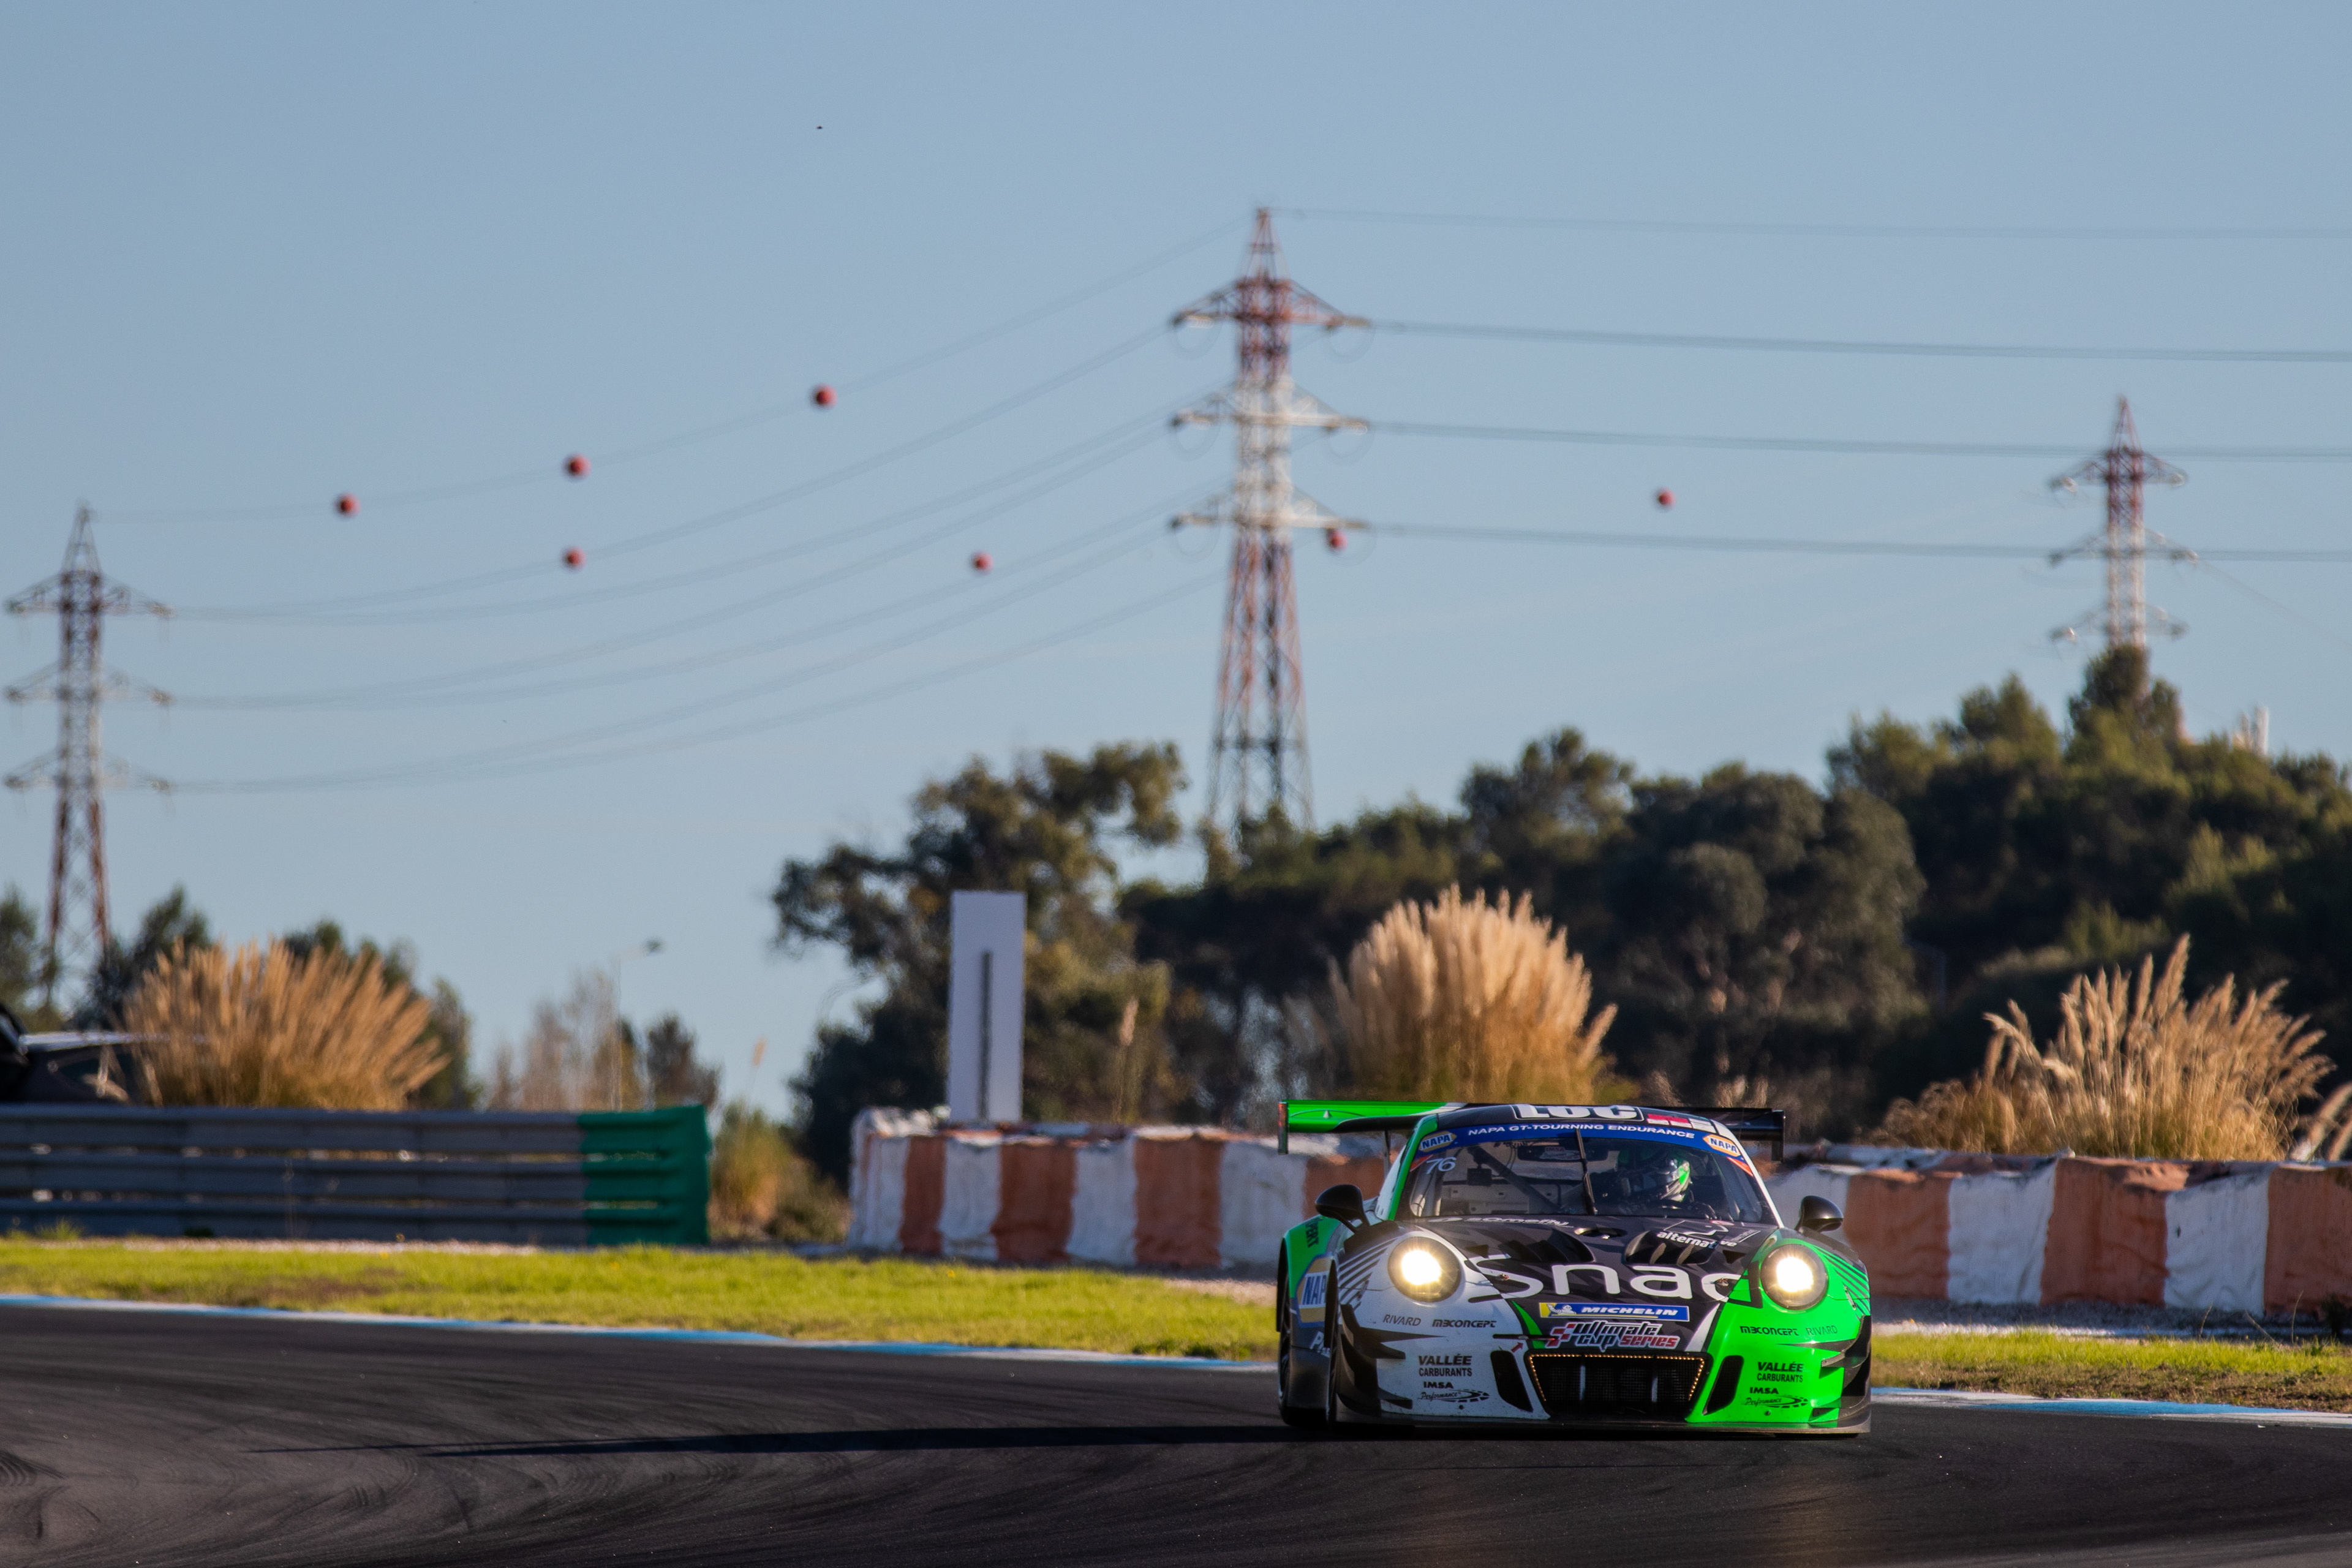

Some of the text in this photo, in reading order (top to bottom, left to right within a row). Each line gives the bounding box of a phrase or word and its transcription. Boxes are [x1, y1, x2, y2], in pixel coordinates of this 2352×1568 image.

[1468, 1126, 1506, 1136] NAPA
[1608, 1125, 1695, 1139] ENDURANCE
[1422, 1134, 1452, 1150] NAPA
[1709, 1137, 1738, 1153] NAPA
[1426, 1156, 1457, 1175] 76
[1581, 1306, 1678, 1316] MICHELIN
[1383, 1314, 1421, 1326] RIVARD
[1806, 1325, 1838, 1335] RIVARD
[1419, 1354, 1472, 1365] VALLÉE
[1757, 1362, 1804, 1372] VALLÉE
[1419, 1368, 1472, 1377] CARBURANTS
[1757, 1373, 1803, 1382] CARBURANTS
[1420, 1392, 1458, 1401] Performance
[1745, 1397, 1782, 1407] Performance
